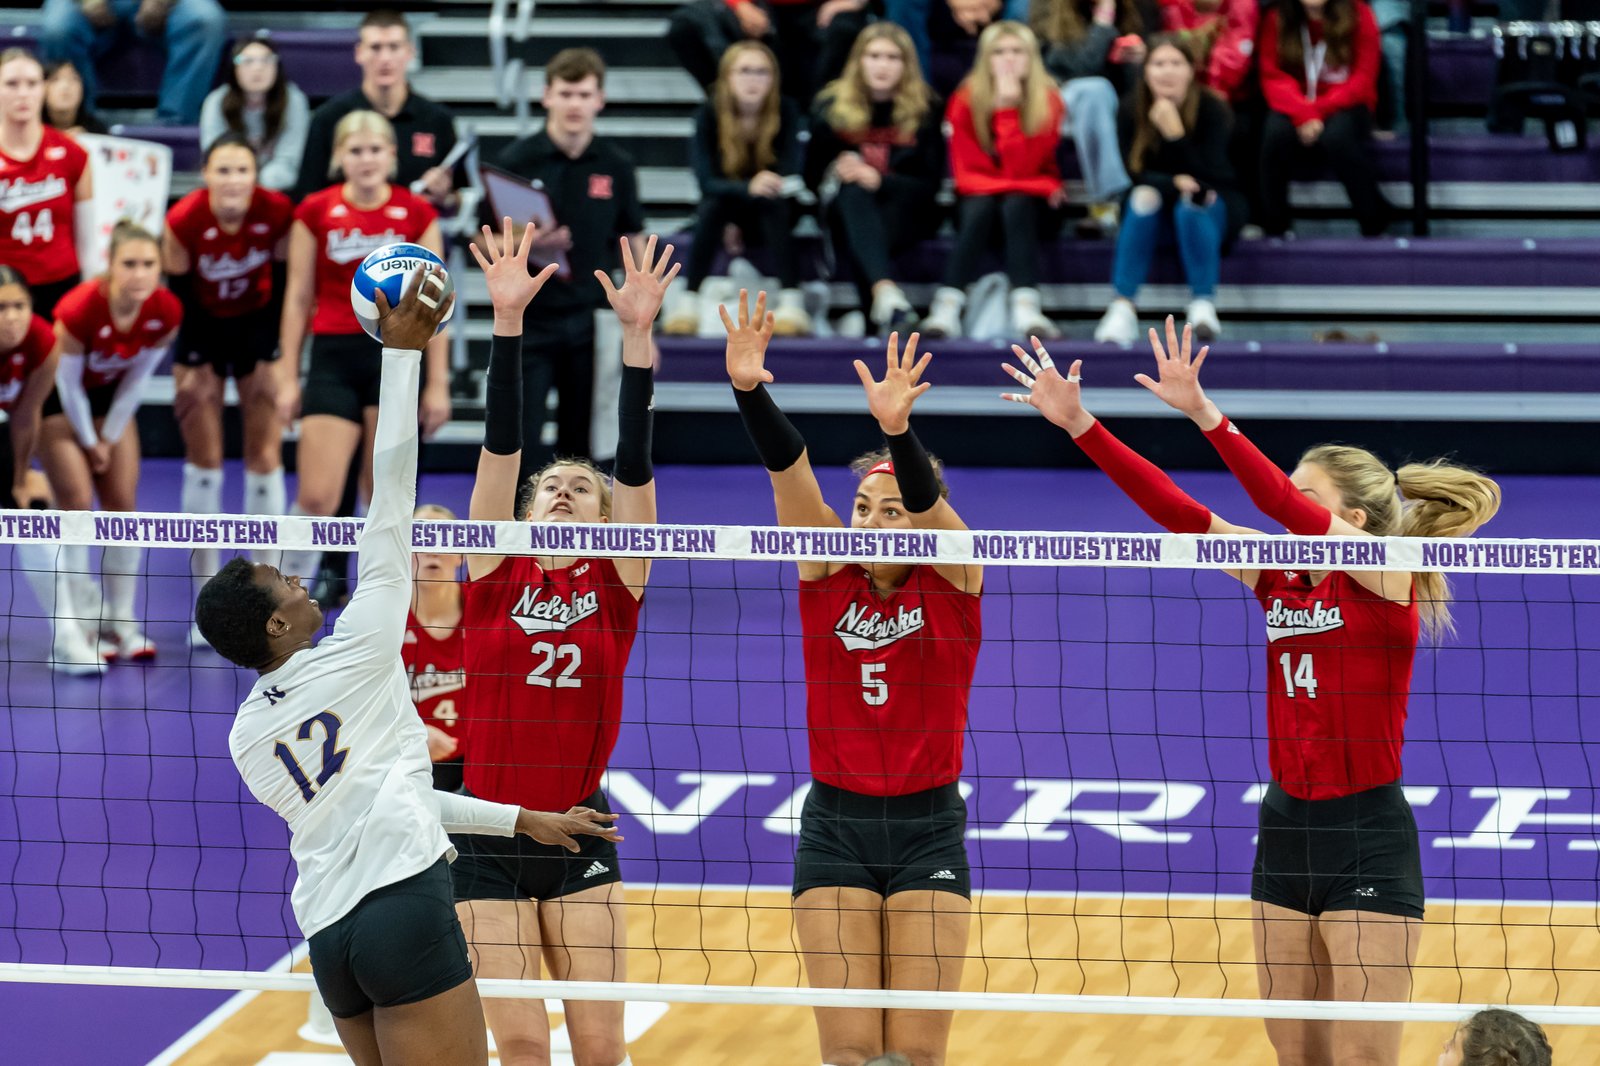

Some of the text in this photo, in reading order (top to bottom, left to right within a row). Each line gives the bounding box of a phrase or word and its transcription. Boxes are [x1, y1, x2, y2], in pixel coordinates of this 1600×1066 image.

[11, 207, 54, 245] 44
[0, 514, 61, 539] TERN
[95, 516, 278, 545] NORTHWESTERN
[530, 525, 716, 553] NORTHWESTERN
[751, 530, 938, 558] NORTHWESTERN
[973, 535, 1162, 562] NORTHWESTERN
[1196, 539, 1387, 566] NORTHWESTERN
[1422, 543, 1600, 569] NORTHWESTER
[1266, 598, 1344, 628] ebraska
[526, 641, 582, 688] 22
[861, 662, 889, 706] 5
[1279, 652, 1318, 698] 14
[432, 699, 459, 727] 4
[273, 708, 351, 803] 12
